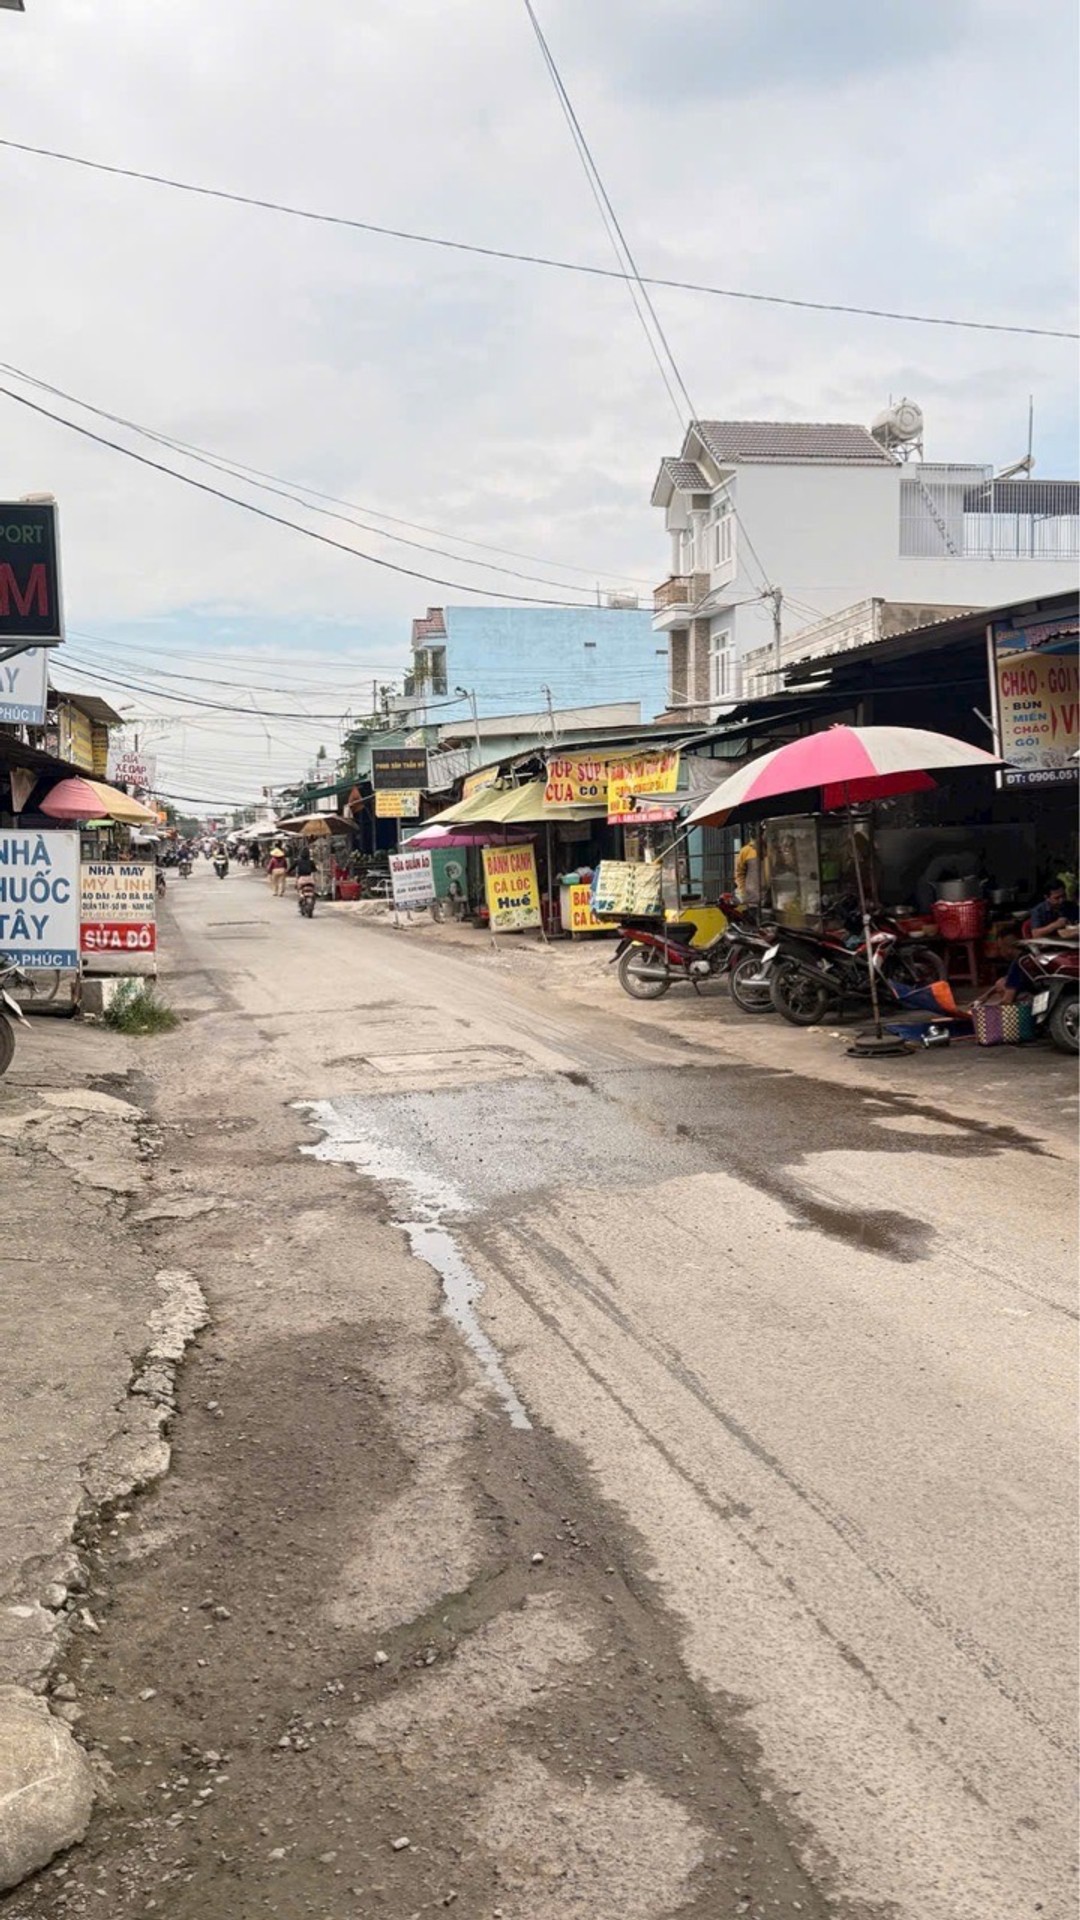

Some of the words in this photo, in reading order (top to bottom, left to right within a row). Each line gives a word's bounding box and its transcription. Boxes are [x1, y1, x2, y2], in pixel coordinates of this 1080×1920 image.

[1001, 663, 1037, 697] CHÁO
[577, 756, 601, 782] SÚP
[545, 783, 574, 802] CUA
[89, 863, 115, 875] NHÀ
[120, 867, 145, 876] MAY
[114, 878, 152, 891] LINH
[497, 891, 532, 909] Huế
[85, 923, 122, 948] SỬA
[22, 952, 63, 966] PHÚC
